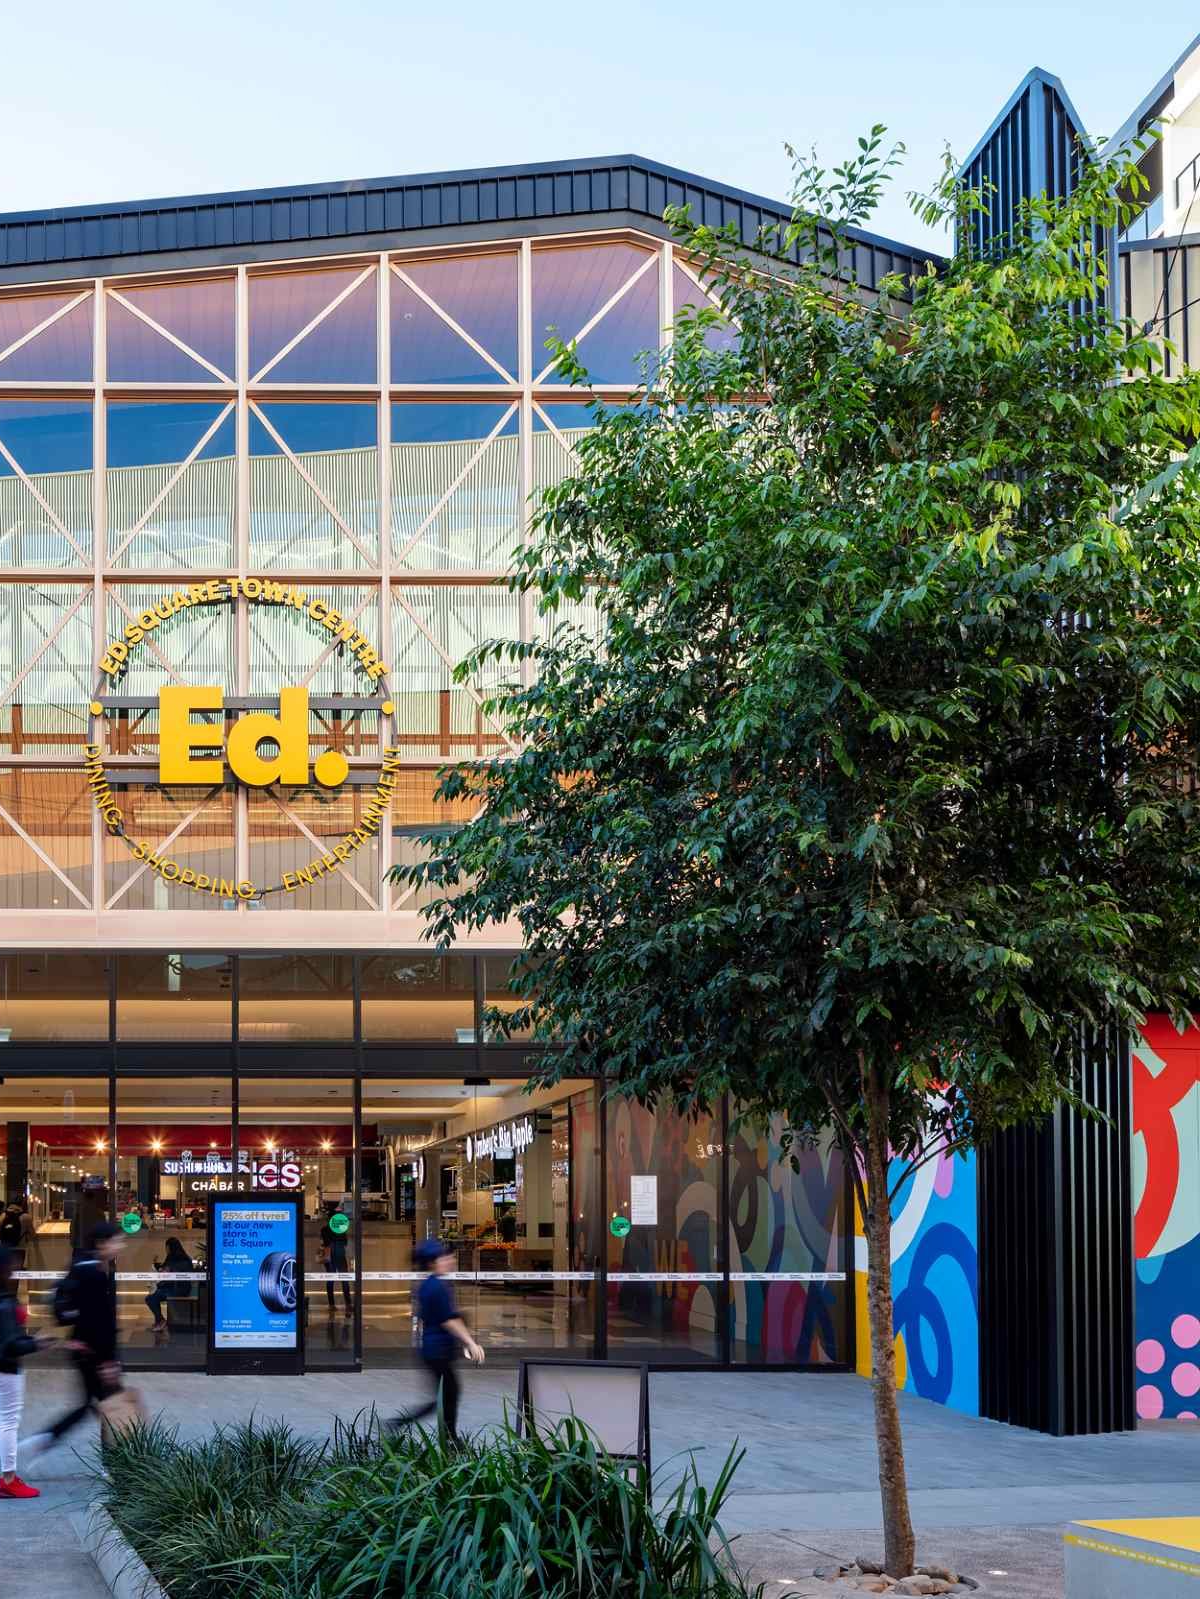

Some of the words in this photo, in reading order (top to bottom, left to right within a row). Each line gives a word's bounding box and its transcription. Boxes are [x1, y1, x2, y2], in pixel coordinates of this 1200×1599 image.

[227, 578, 306, 610] TOWN
[308, 598, 389, 681] CENTRE
[159, 686, 349, 789] Ed.
[83, 743, 123, 827] DINING
[131, 840, 257, 899] SHOPPING
[281, 746, 402, 893] ENTERTAINMENT
[512, 1117, 534, 1153] Apple
[240, 1238, 273, 1248] Square
[250, 1230, 258, 1238] in
